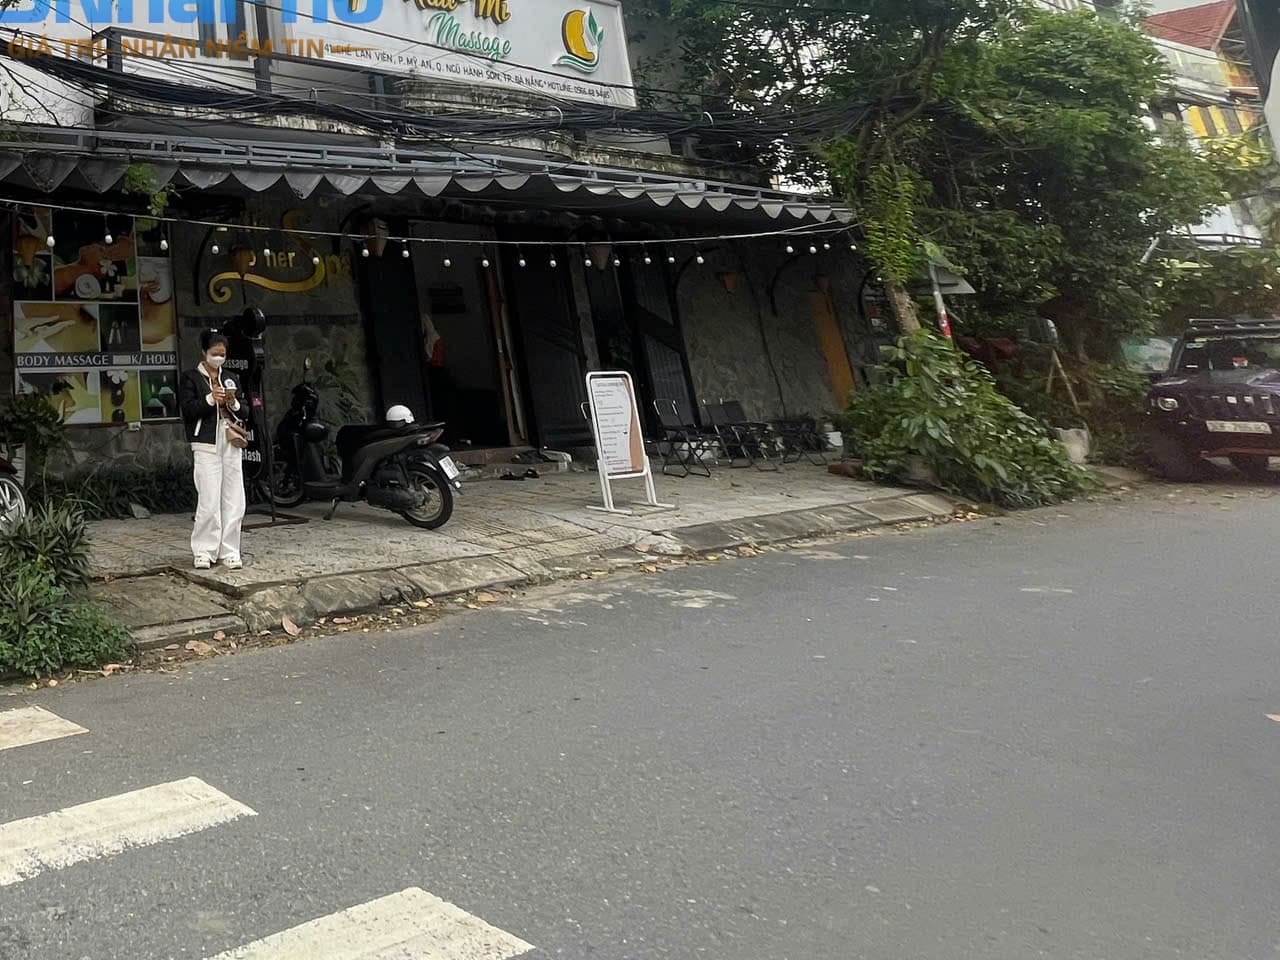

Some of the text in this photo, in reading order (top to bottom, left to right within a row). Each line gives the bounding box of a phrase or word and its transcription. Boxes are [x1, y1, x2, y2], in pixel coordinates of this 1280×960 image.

[430, 12, 512, 62] Massage
[17, 354, 50, 366] BODY
[54, 354, 109, 366] MASSAGE
[146, 353, 177, 365] HOUR
